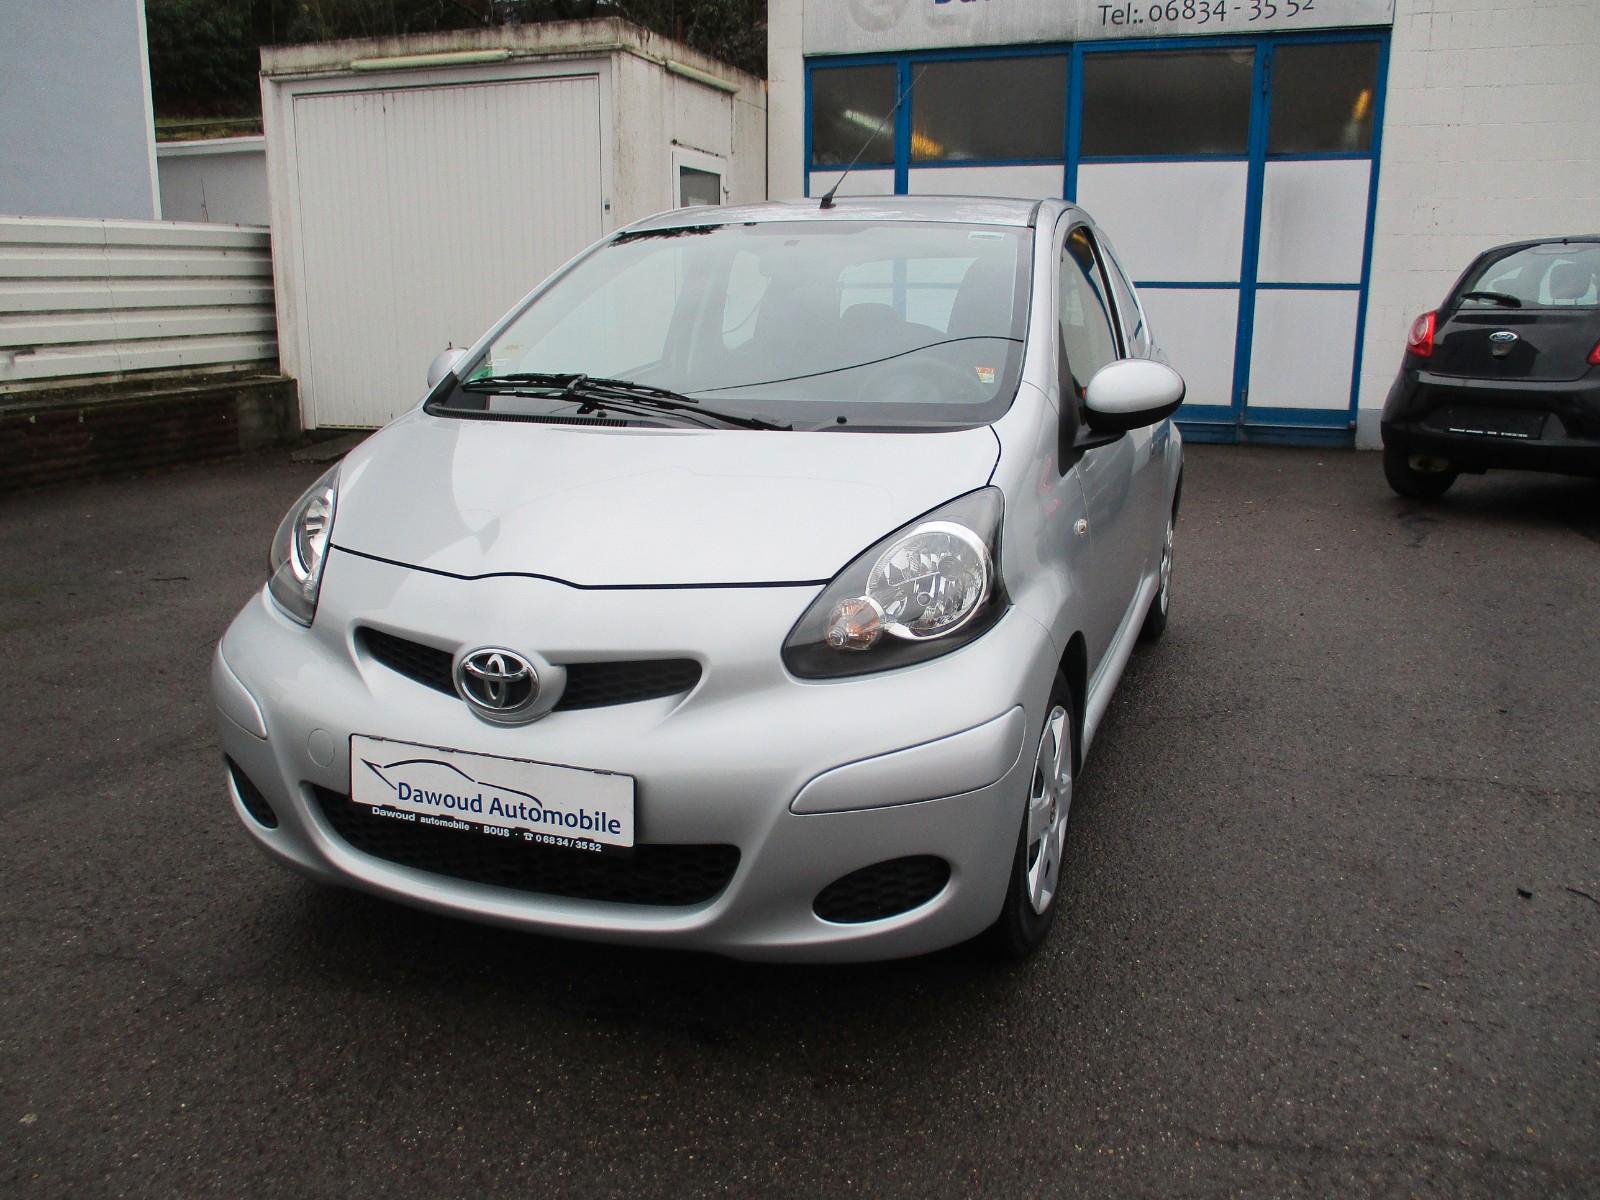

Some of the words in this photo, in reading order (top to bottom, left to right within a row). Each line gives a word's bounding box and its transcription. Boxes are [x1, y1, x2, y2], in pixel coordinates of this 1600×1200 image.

[1149, 0, 1227, 24] 06834
[372, 806, 416, 821] Dawoud
[420, 816, 470, 830] automobile
[483, 825, 510, 837] BOUS
[398, 782, 482, 813] Dawoud
[489, 797, 621, 834] Automobile
